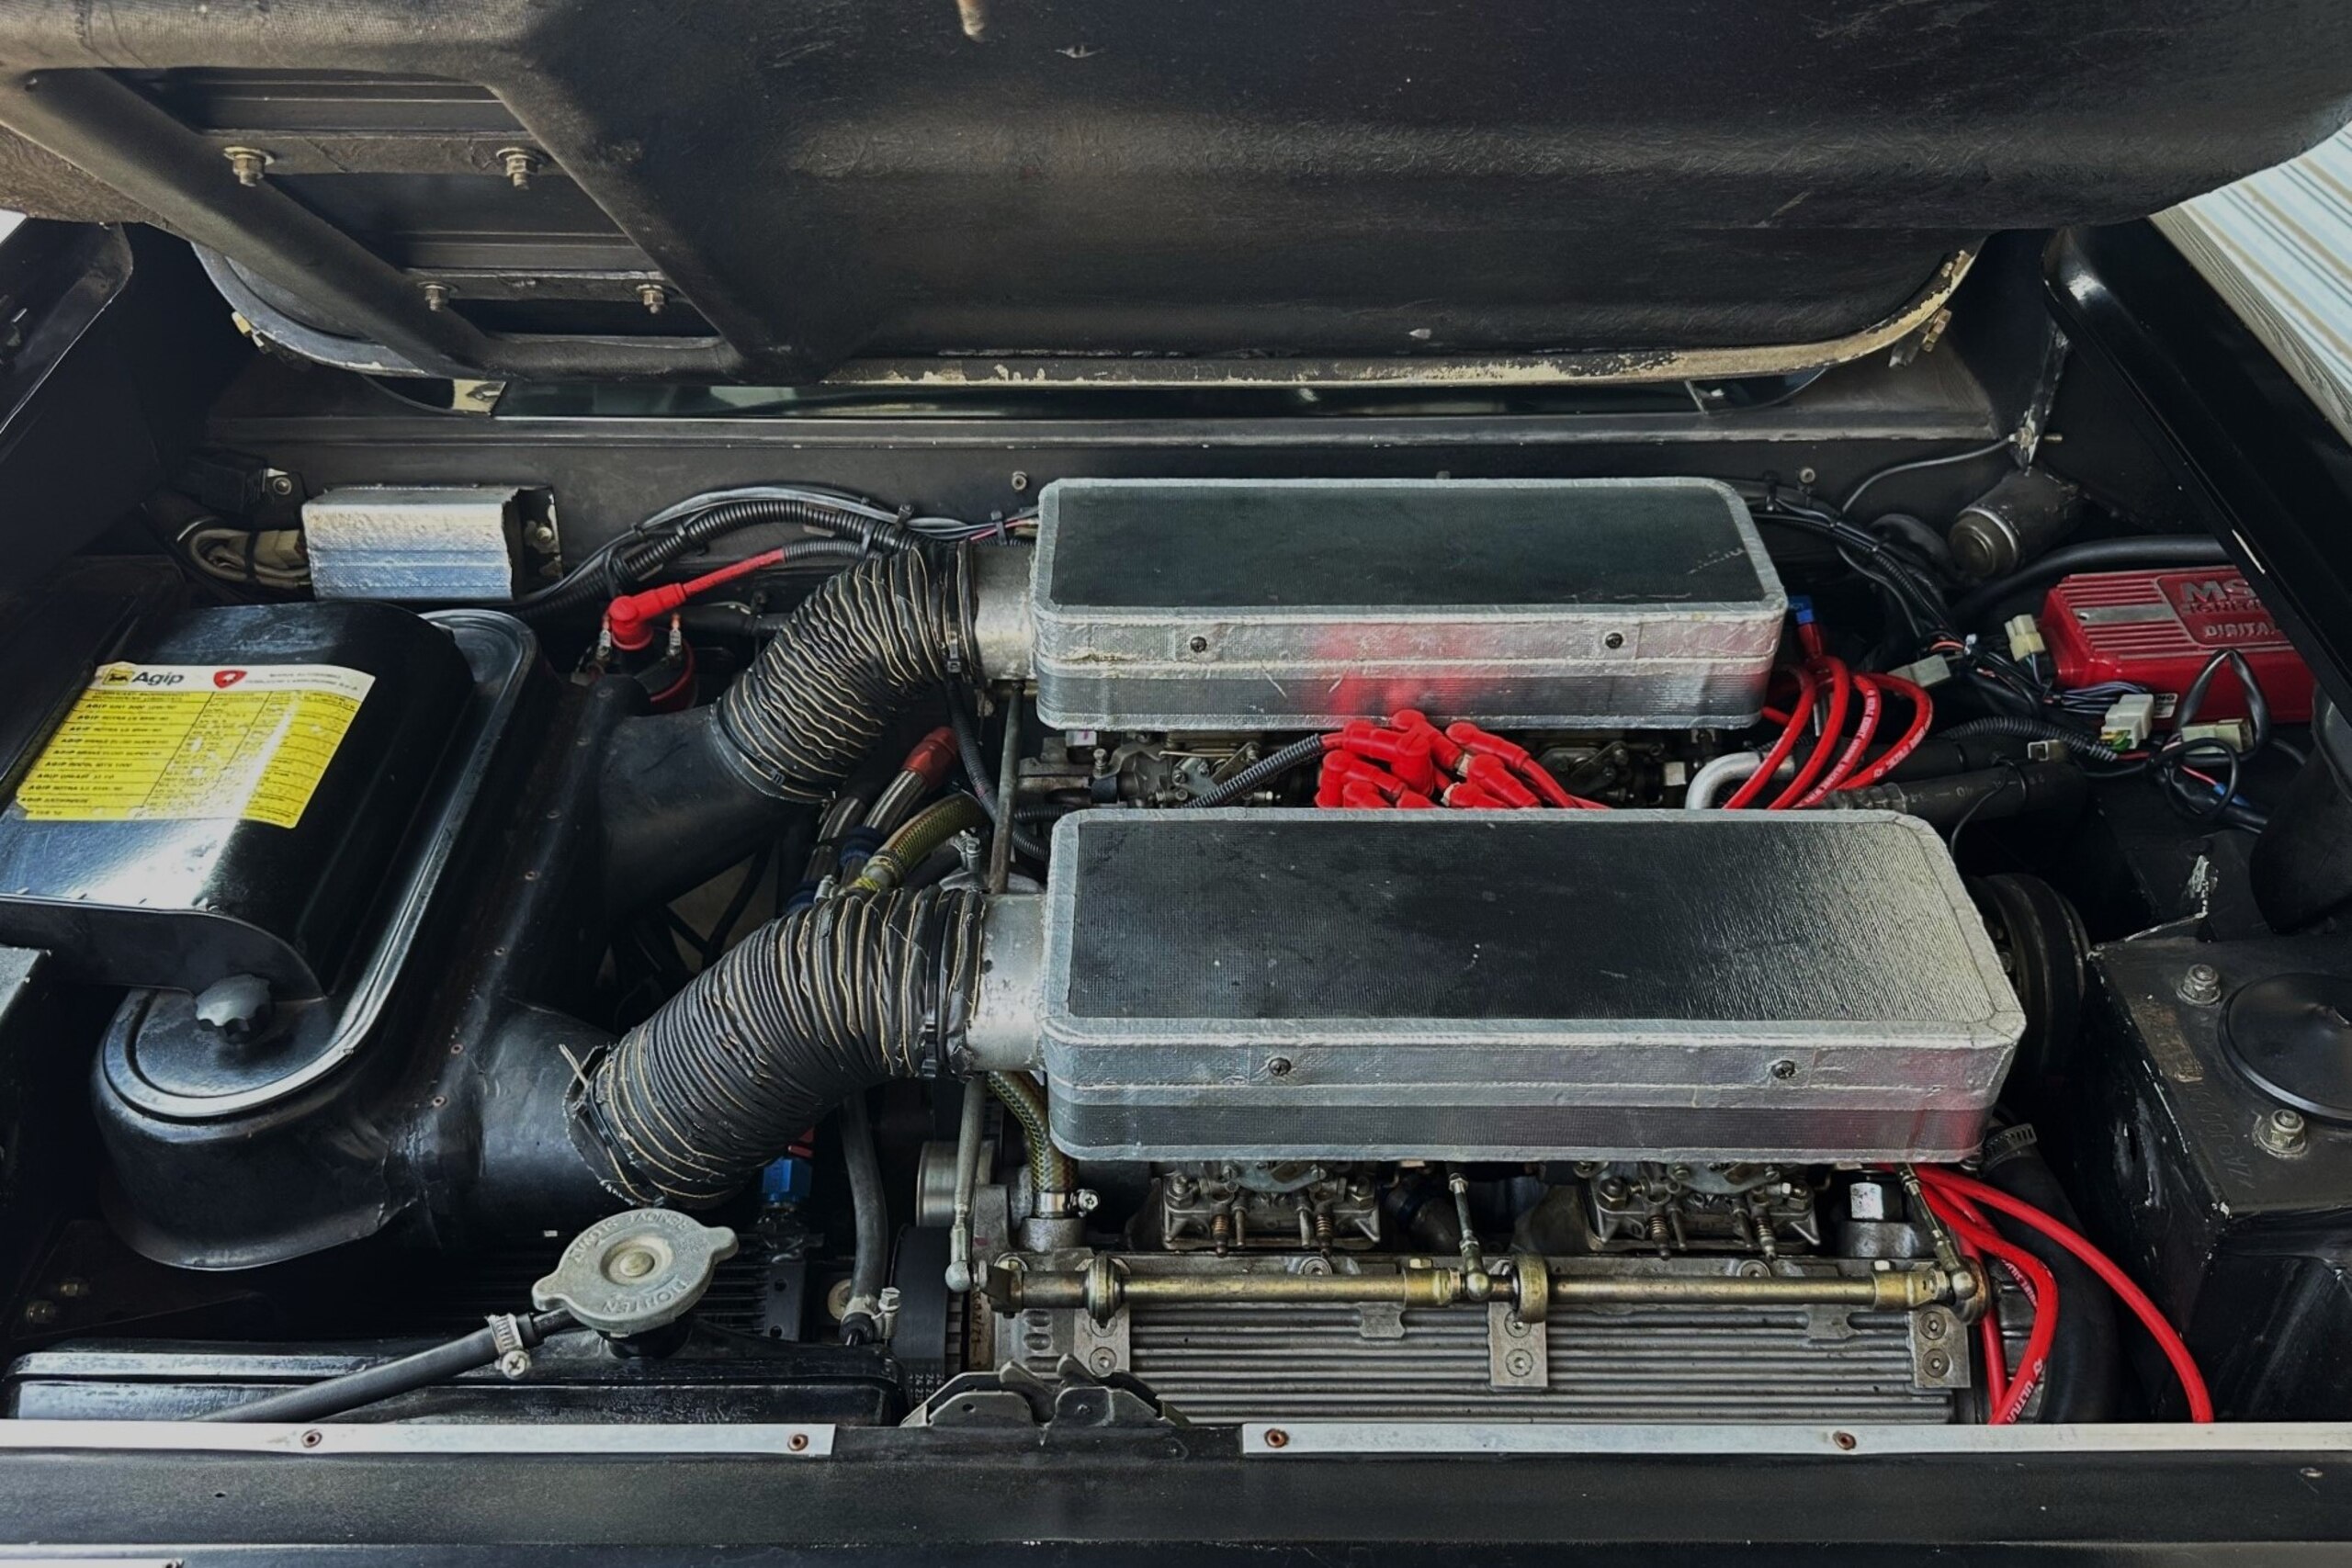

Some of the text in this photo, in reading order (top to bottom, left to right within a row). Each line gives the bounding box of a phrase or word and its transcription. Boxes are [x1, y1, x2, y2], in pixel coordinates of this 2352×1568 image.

[2181, 578, 2257, 603] MS
[2204, 622, 2276, 637] DIGITA
[131, 671, 185, 686] Agip
[602, 1277, 692, 1314] TIGHTEN
